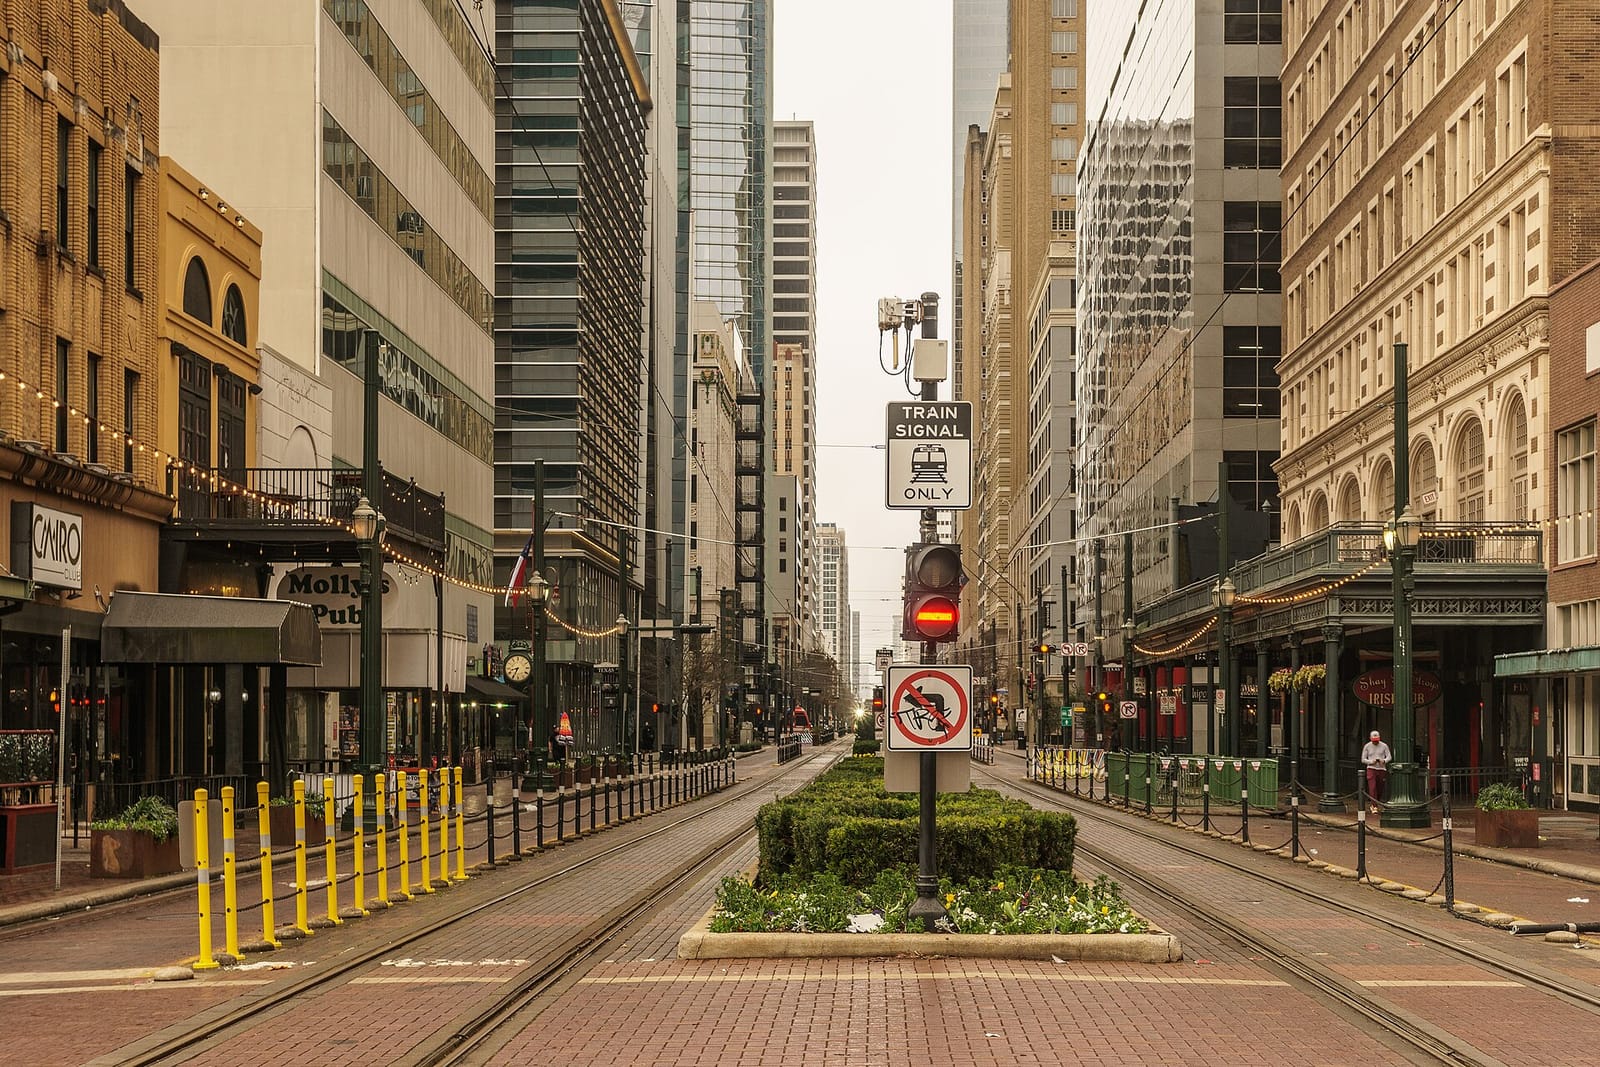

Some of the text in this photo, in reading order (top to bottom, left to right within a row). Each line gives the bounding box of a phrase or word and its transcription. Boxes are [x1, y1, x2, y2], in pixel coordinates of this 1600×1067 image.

[902, 406, 958, 419] TRAIN
[895, 424, 964, 437] SIGNAL
[904, 487, 954, 500] ONLY
[33, 513, 81, 566] CAIRO
[288, 573, 390, 599] Mollys
[311, 603, 362, 625] Pub
